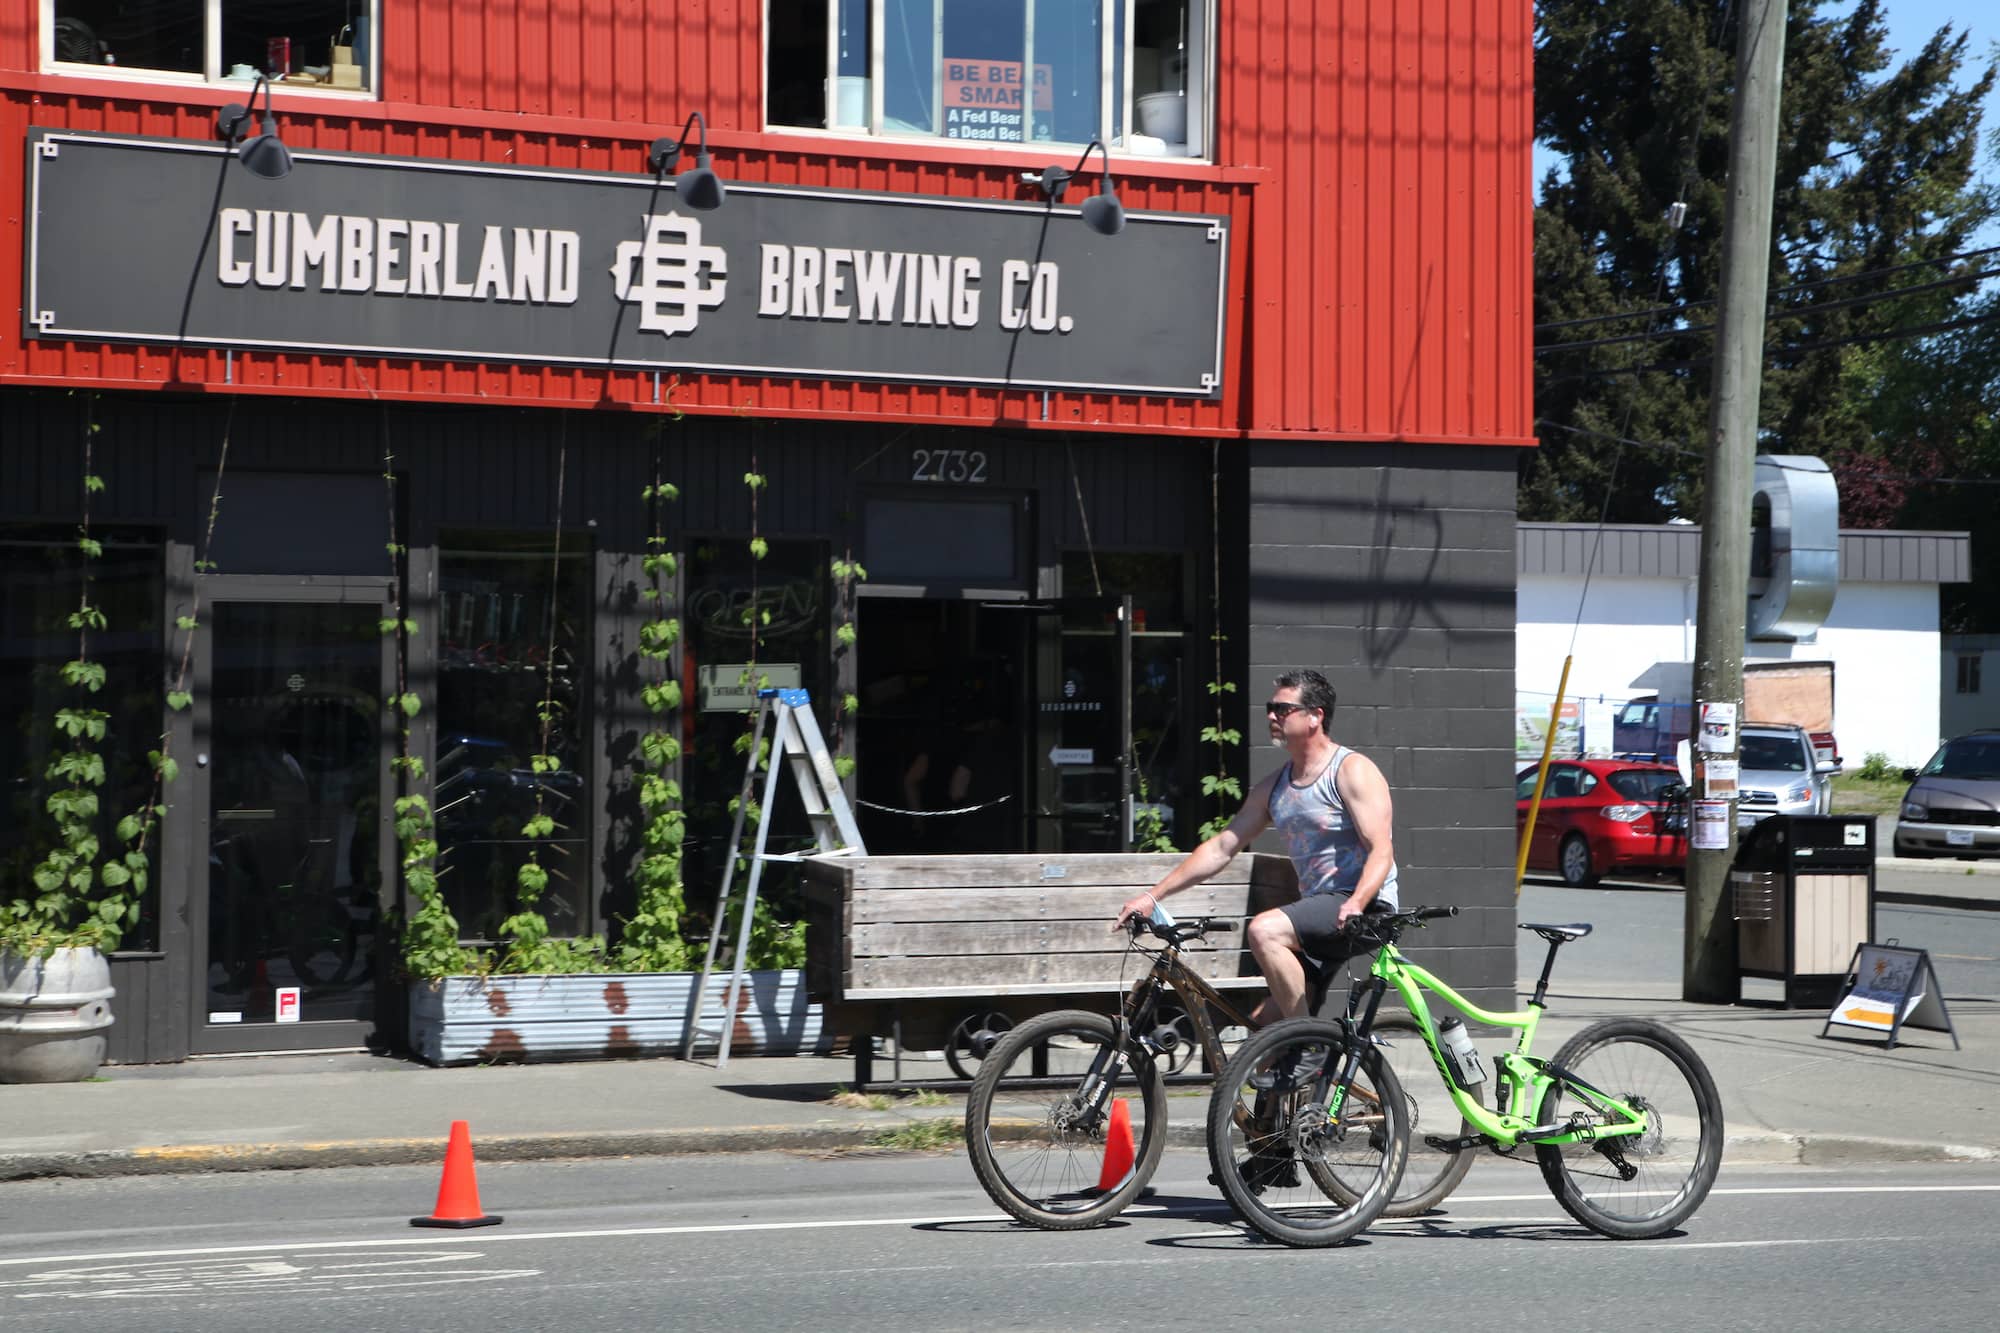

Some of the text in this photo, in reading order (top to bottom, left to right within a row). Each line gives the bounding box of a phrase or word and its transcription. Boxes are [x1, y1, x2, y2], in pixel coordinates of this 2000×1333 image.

[949, 64, 980, 81] BE
[948, 109, 959, 122] A
[962, 110, 987, 123] Fed
[948, 127, 958, 138] a
[961, 125, 995, 139] Dead
[217, 207, 580, 304] CUMBERLAND
[758, 243, 981, 328] BREWING
[1000, 259, 1074, 333] CO.
[911, 448, 987, 483] 2732
